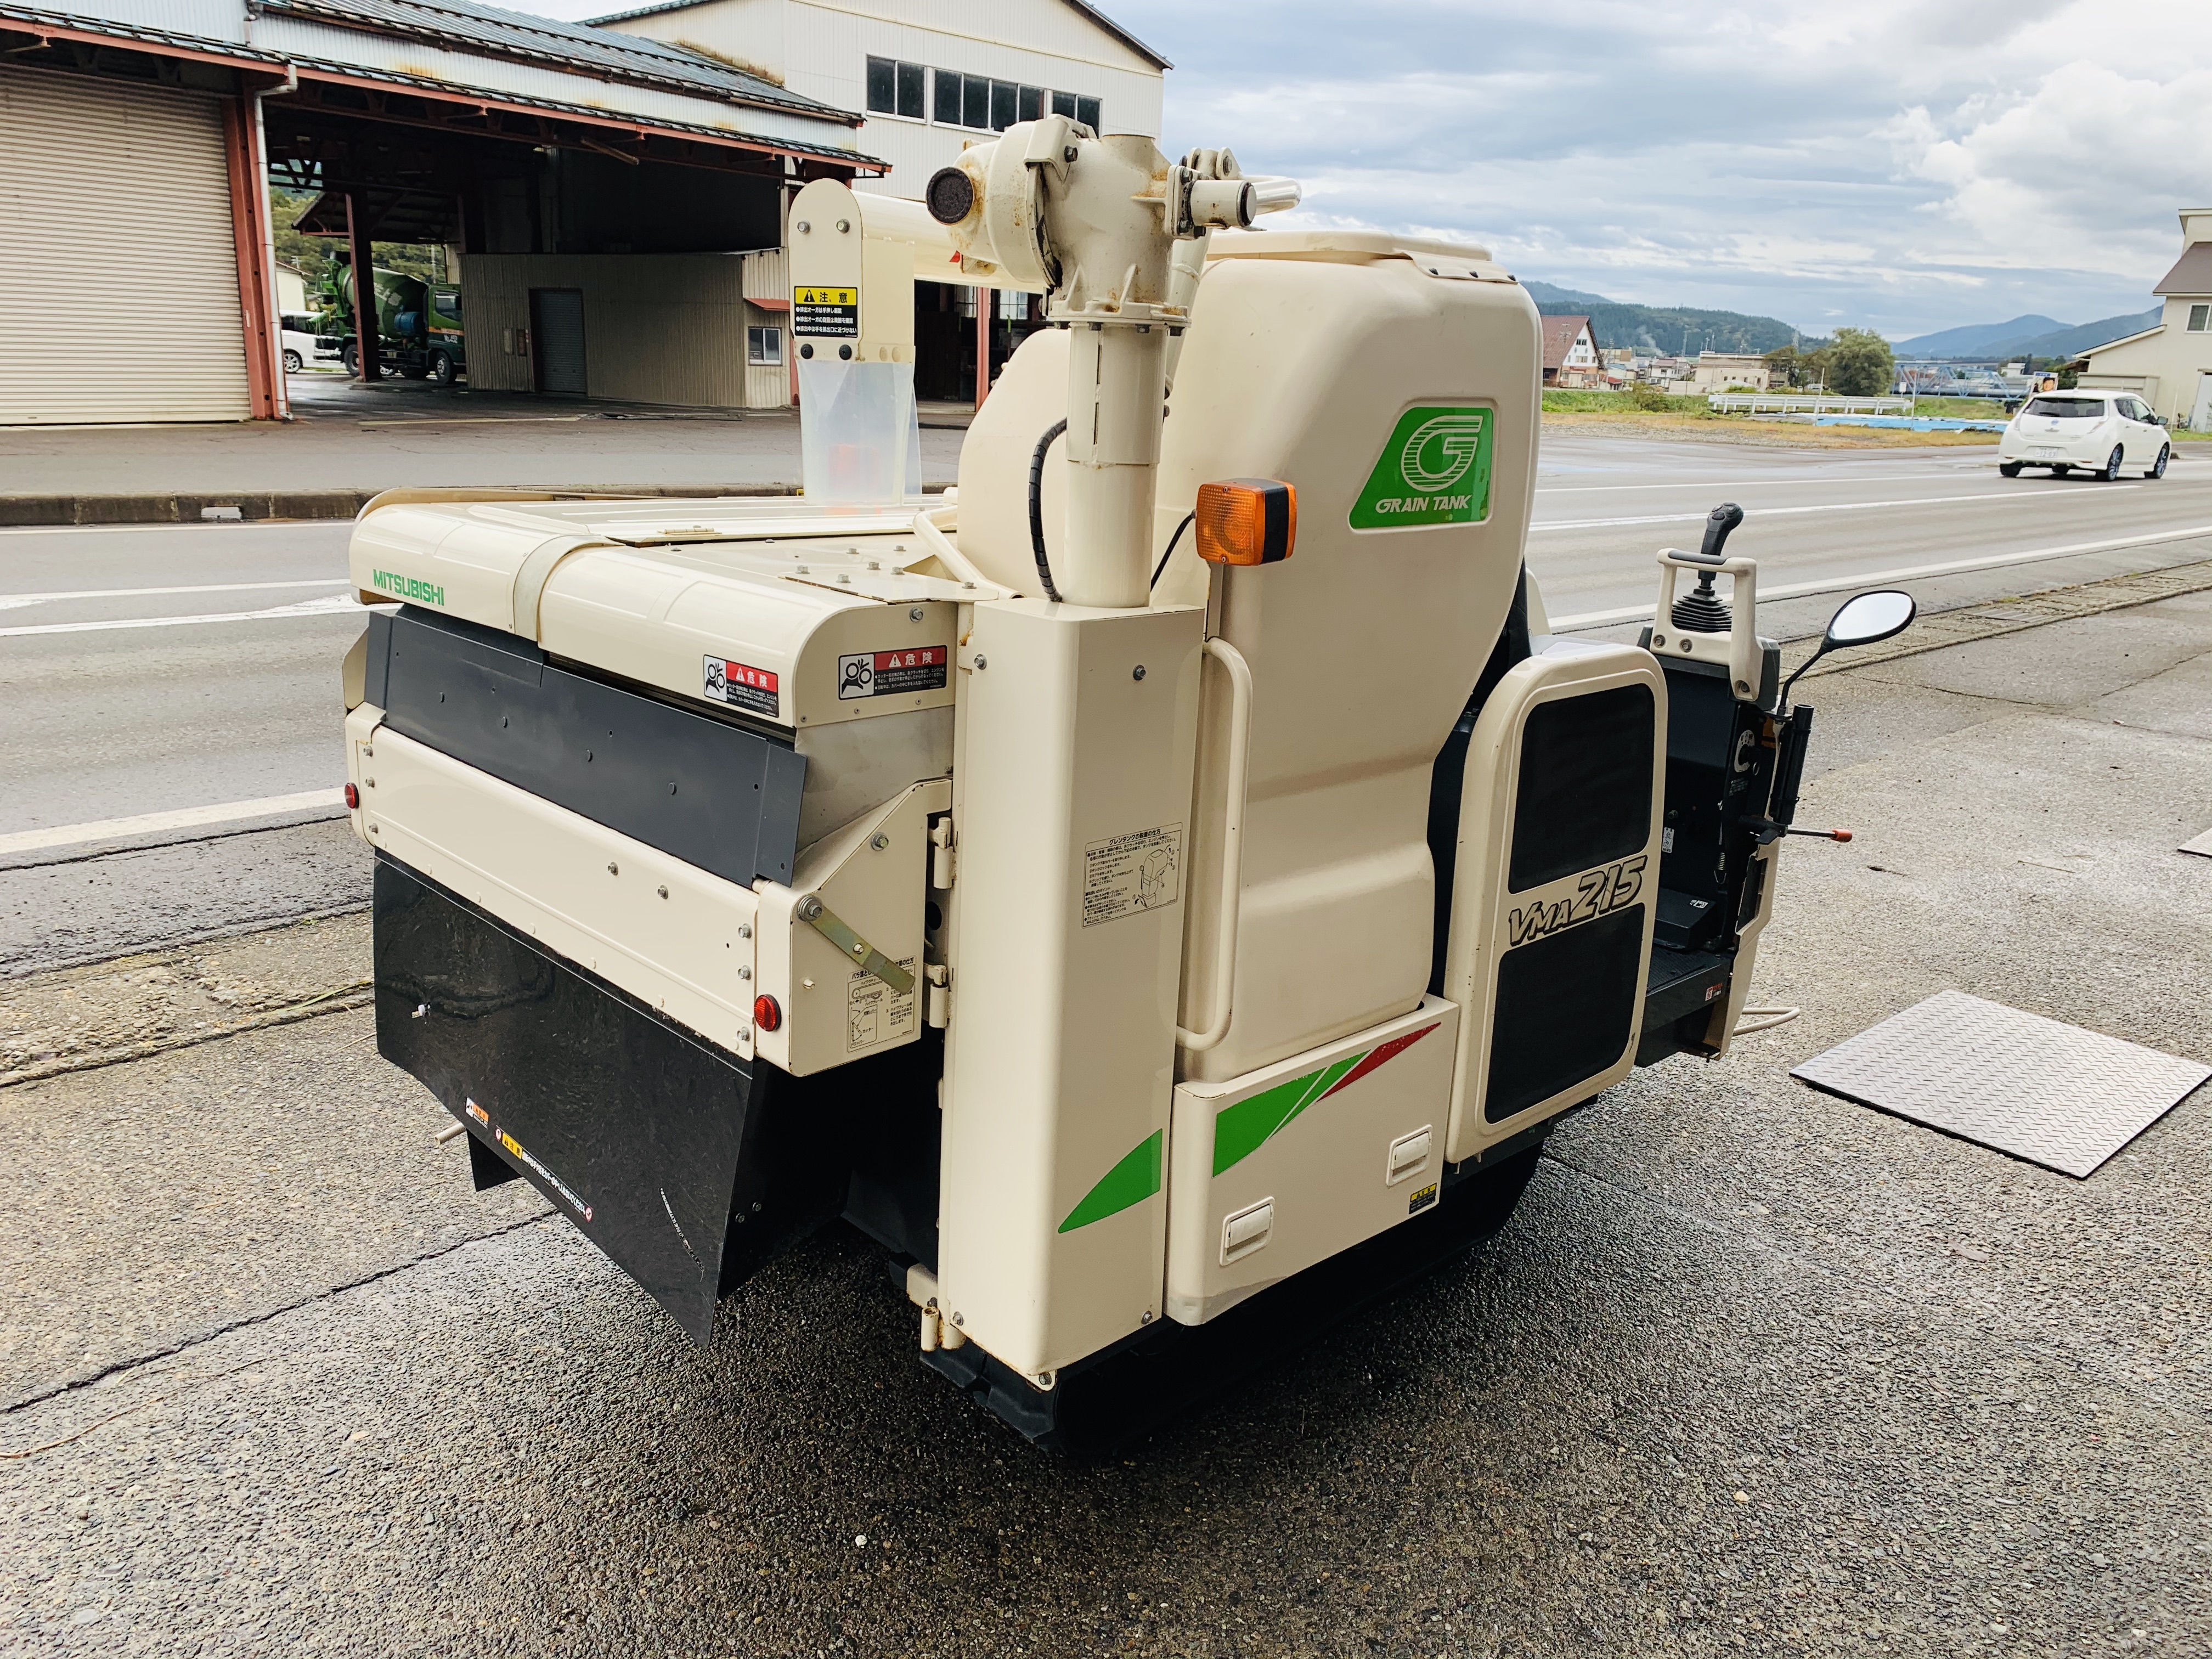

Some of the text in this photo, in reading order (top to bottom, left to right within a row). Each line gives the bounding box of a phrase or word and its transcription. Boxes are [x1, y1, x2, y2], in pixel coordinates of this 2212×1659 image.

[1375, 495, 1473, 514] GRAIN TANK
[373, 568, 444, 606] MITSUBISHI
